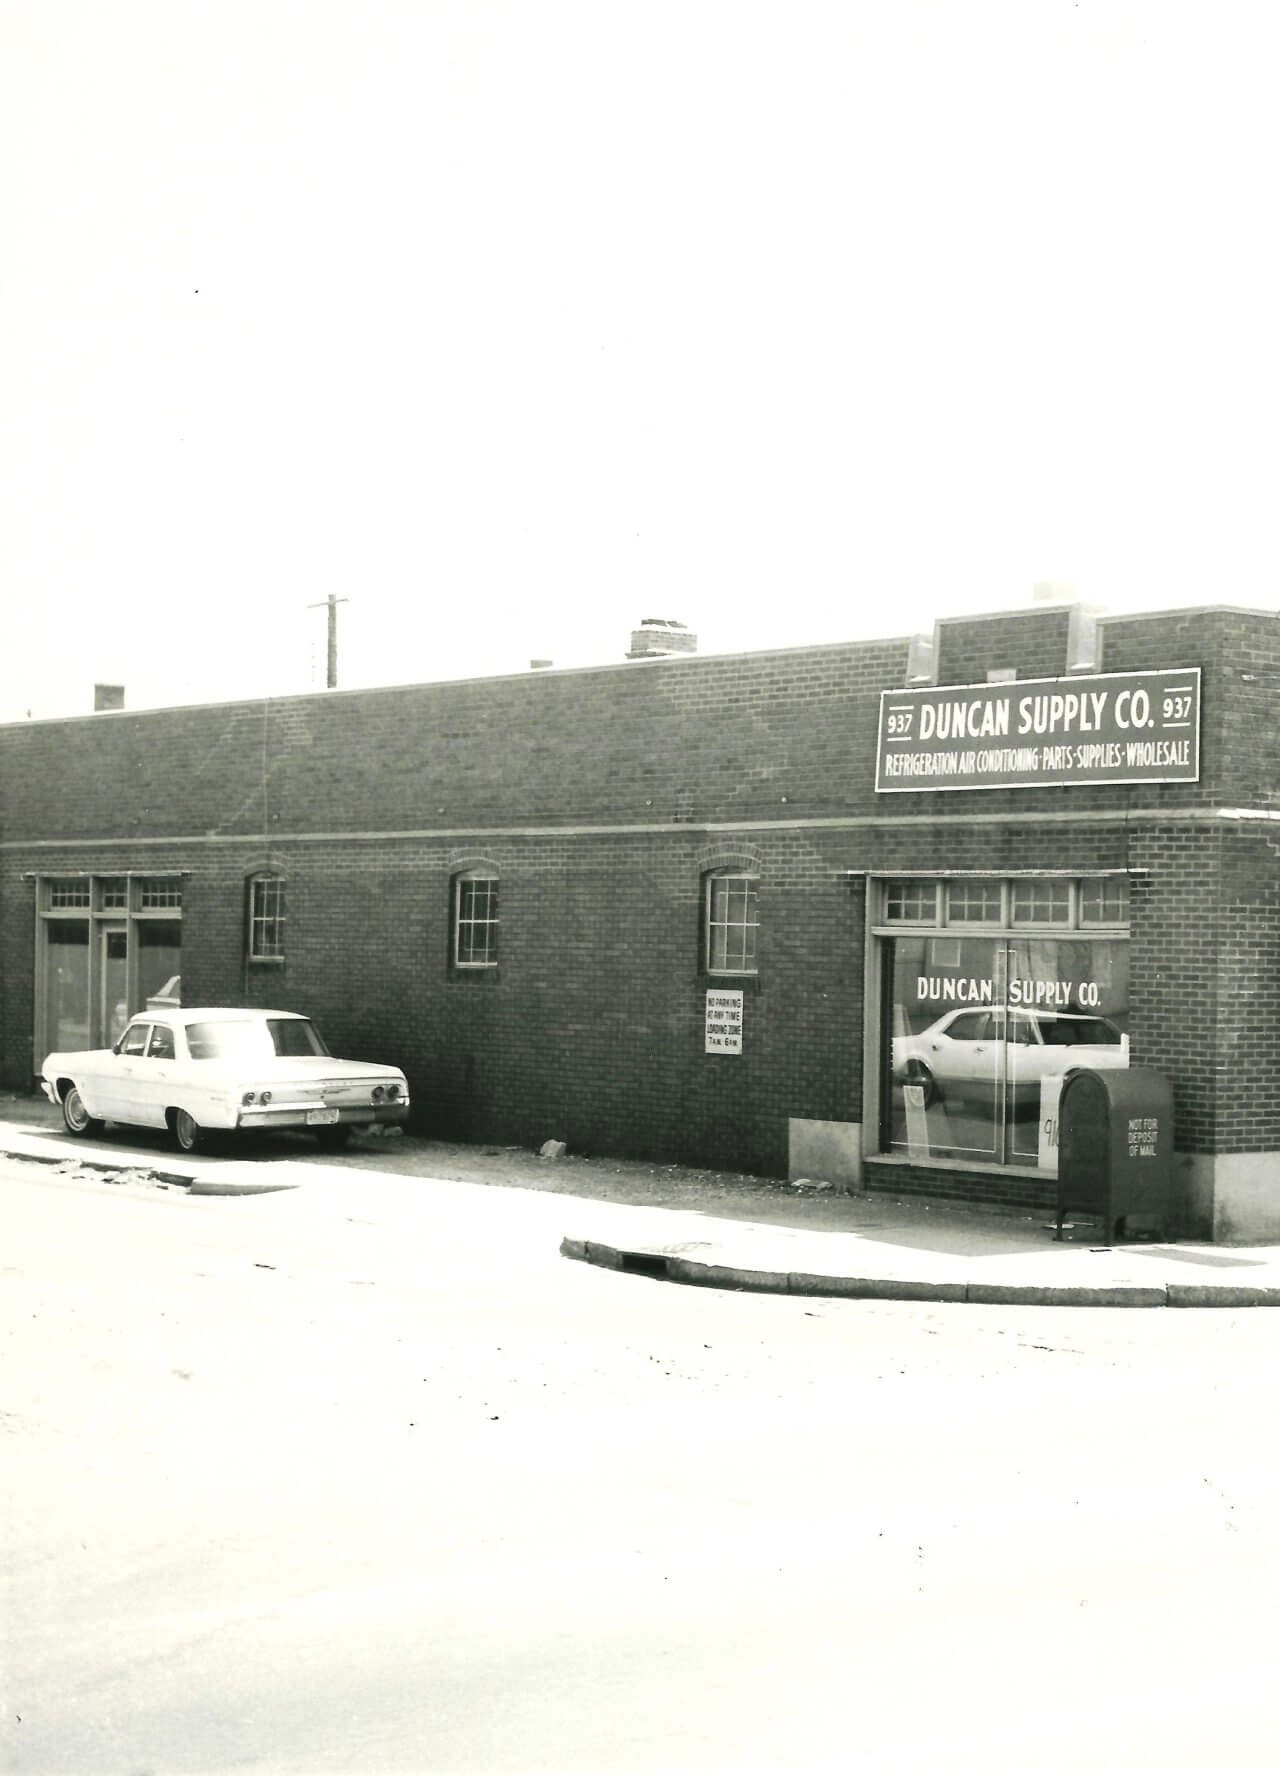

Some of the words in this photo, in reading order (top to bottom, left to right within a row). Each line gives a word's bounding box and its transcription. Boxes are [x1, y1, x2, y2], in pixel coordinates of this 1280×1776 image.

[887, 713, 913, 733] 937
[919, 699, 1010, 740] DUNCAN
[1018, 692, 1108, 735] SUPPLY
[1115, 689, 1155, 729] CO.
[1162, 696, 1192, 719] 937
[885, 752, 958, 777] REFRIGERATION
[958, 751, 976, 774] AIR
[976, 747, 1039, 773] CONDITIONING
[1042, 745, 1073, 770] PARTS
[1076, 743, 1121, 769] SUPPLIES
[1126, 740, 1190, 767] WHOLESALE
[917, 976, 992, 1001] DUNCAN
[1008, 979, 1072, 1005] SUPPLY
[1078, 982, 1102, 1006] CO.
